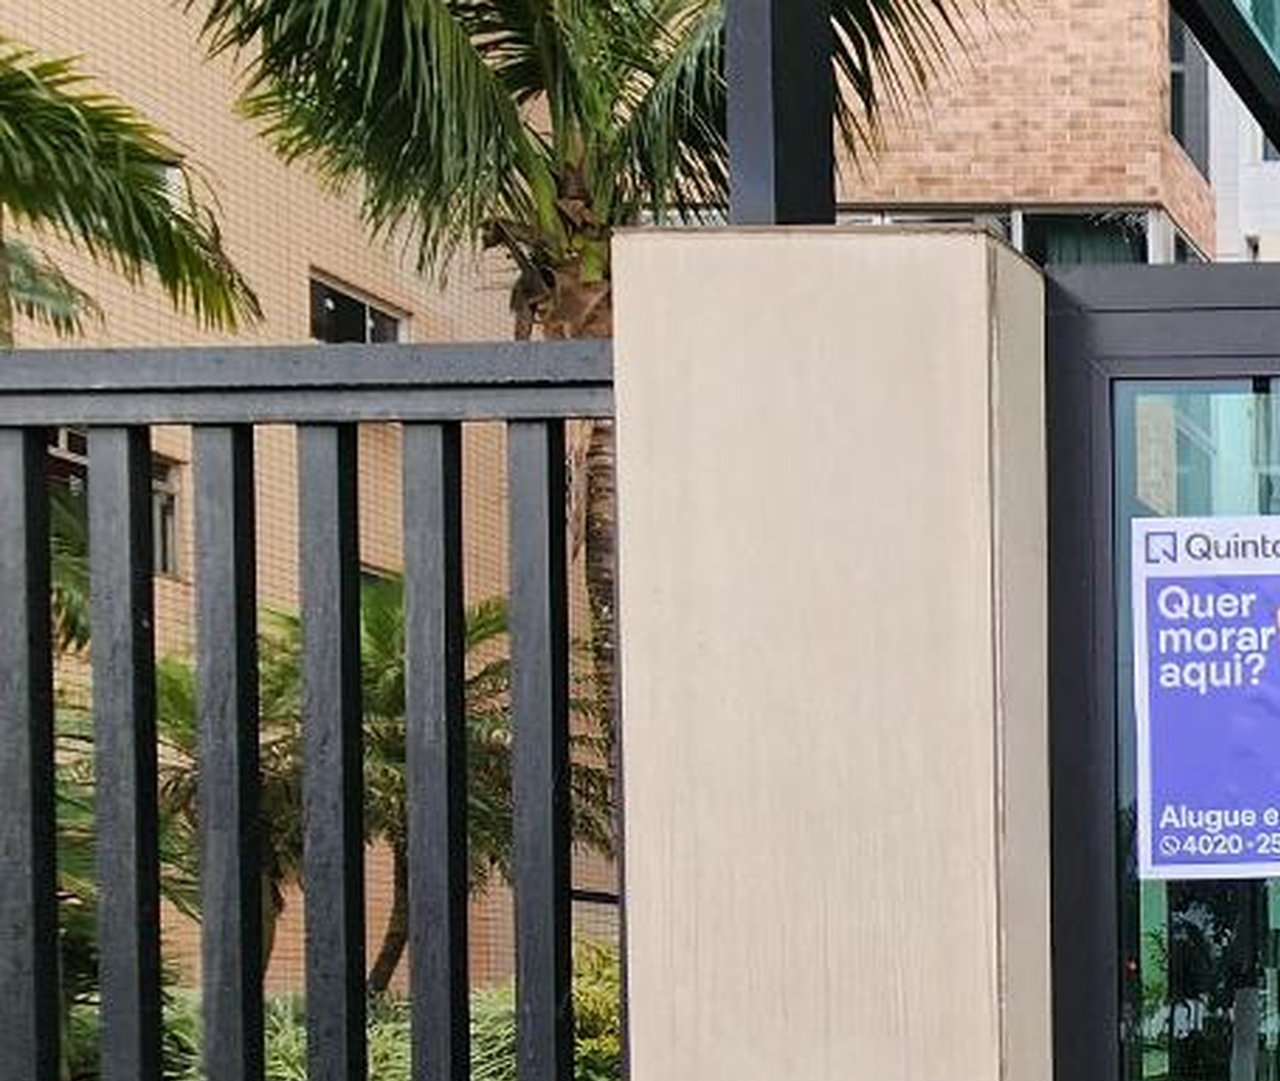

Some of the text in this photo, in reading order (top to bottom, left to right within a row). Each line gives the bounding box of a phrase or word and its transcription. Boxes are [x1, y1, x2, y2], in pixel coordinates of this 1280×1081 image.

[1157, 585, 1257, 620] Quer
[1159, 624, 1276, 653] morar
[1159, 653, 1266, 694] aqui?
[1159, 804, 1256, 834] Alugue
